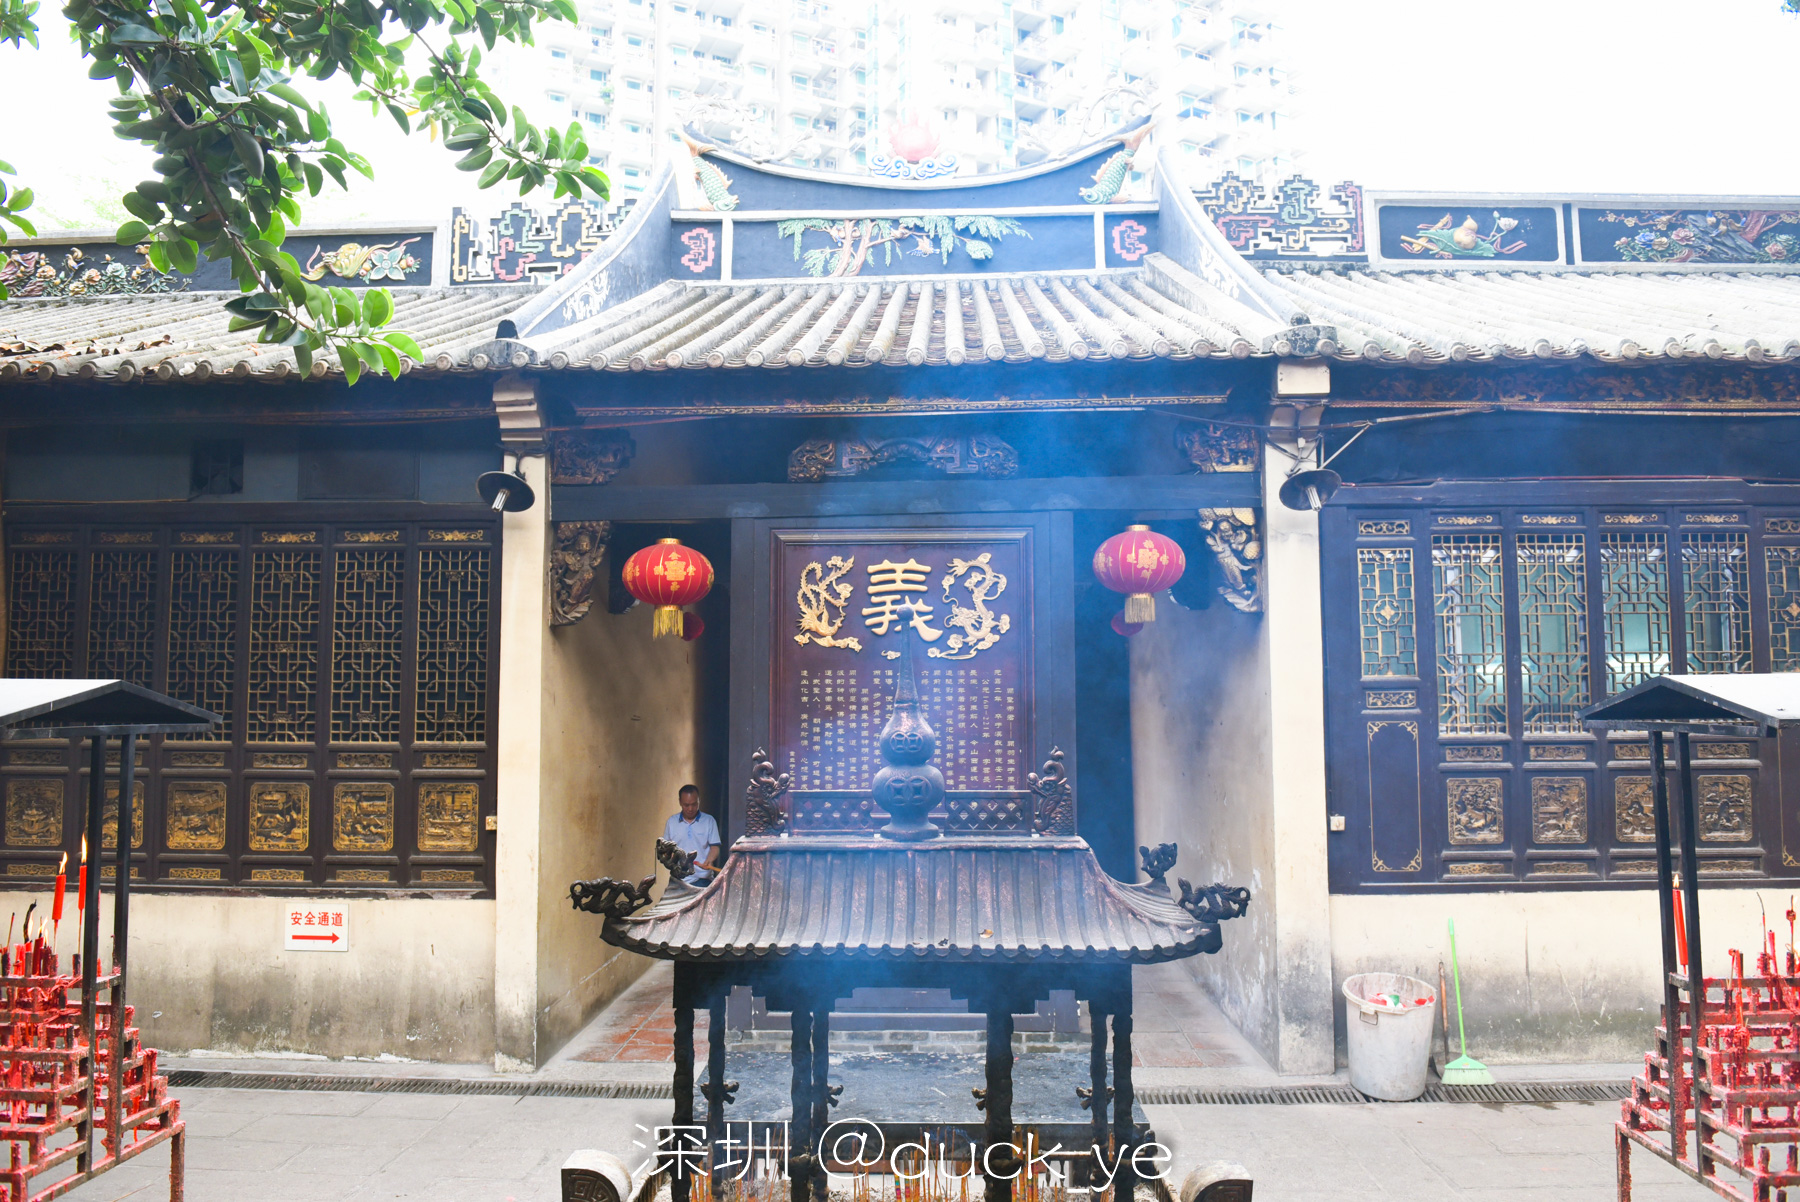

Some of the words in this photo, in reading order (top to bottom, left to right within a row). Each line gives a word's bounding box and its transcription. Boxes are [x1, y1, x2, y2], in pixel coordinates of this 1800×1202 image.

[861, 558, 944, 643] 義
[290, 911, 344, 927] 安全通道
